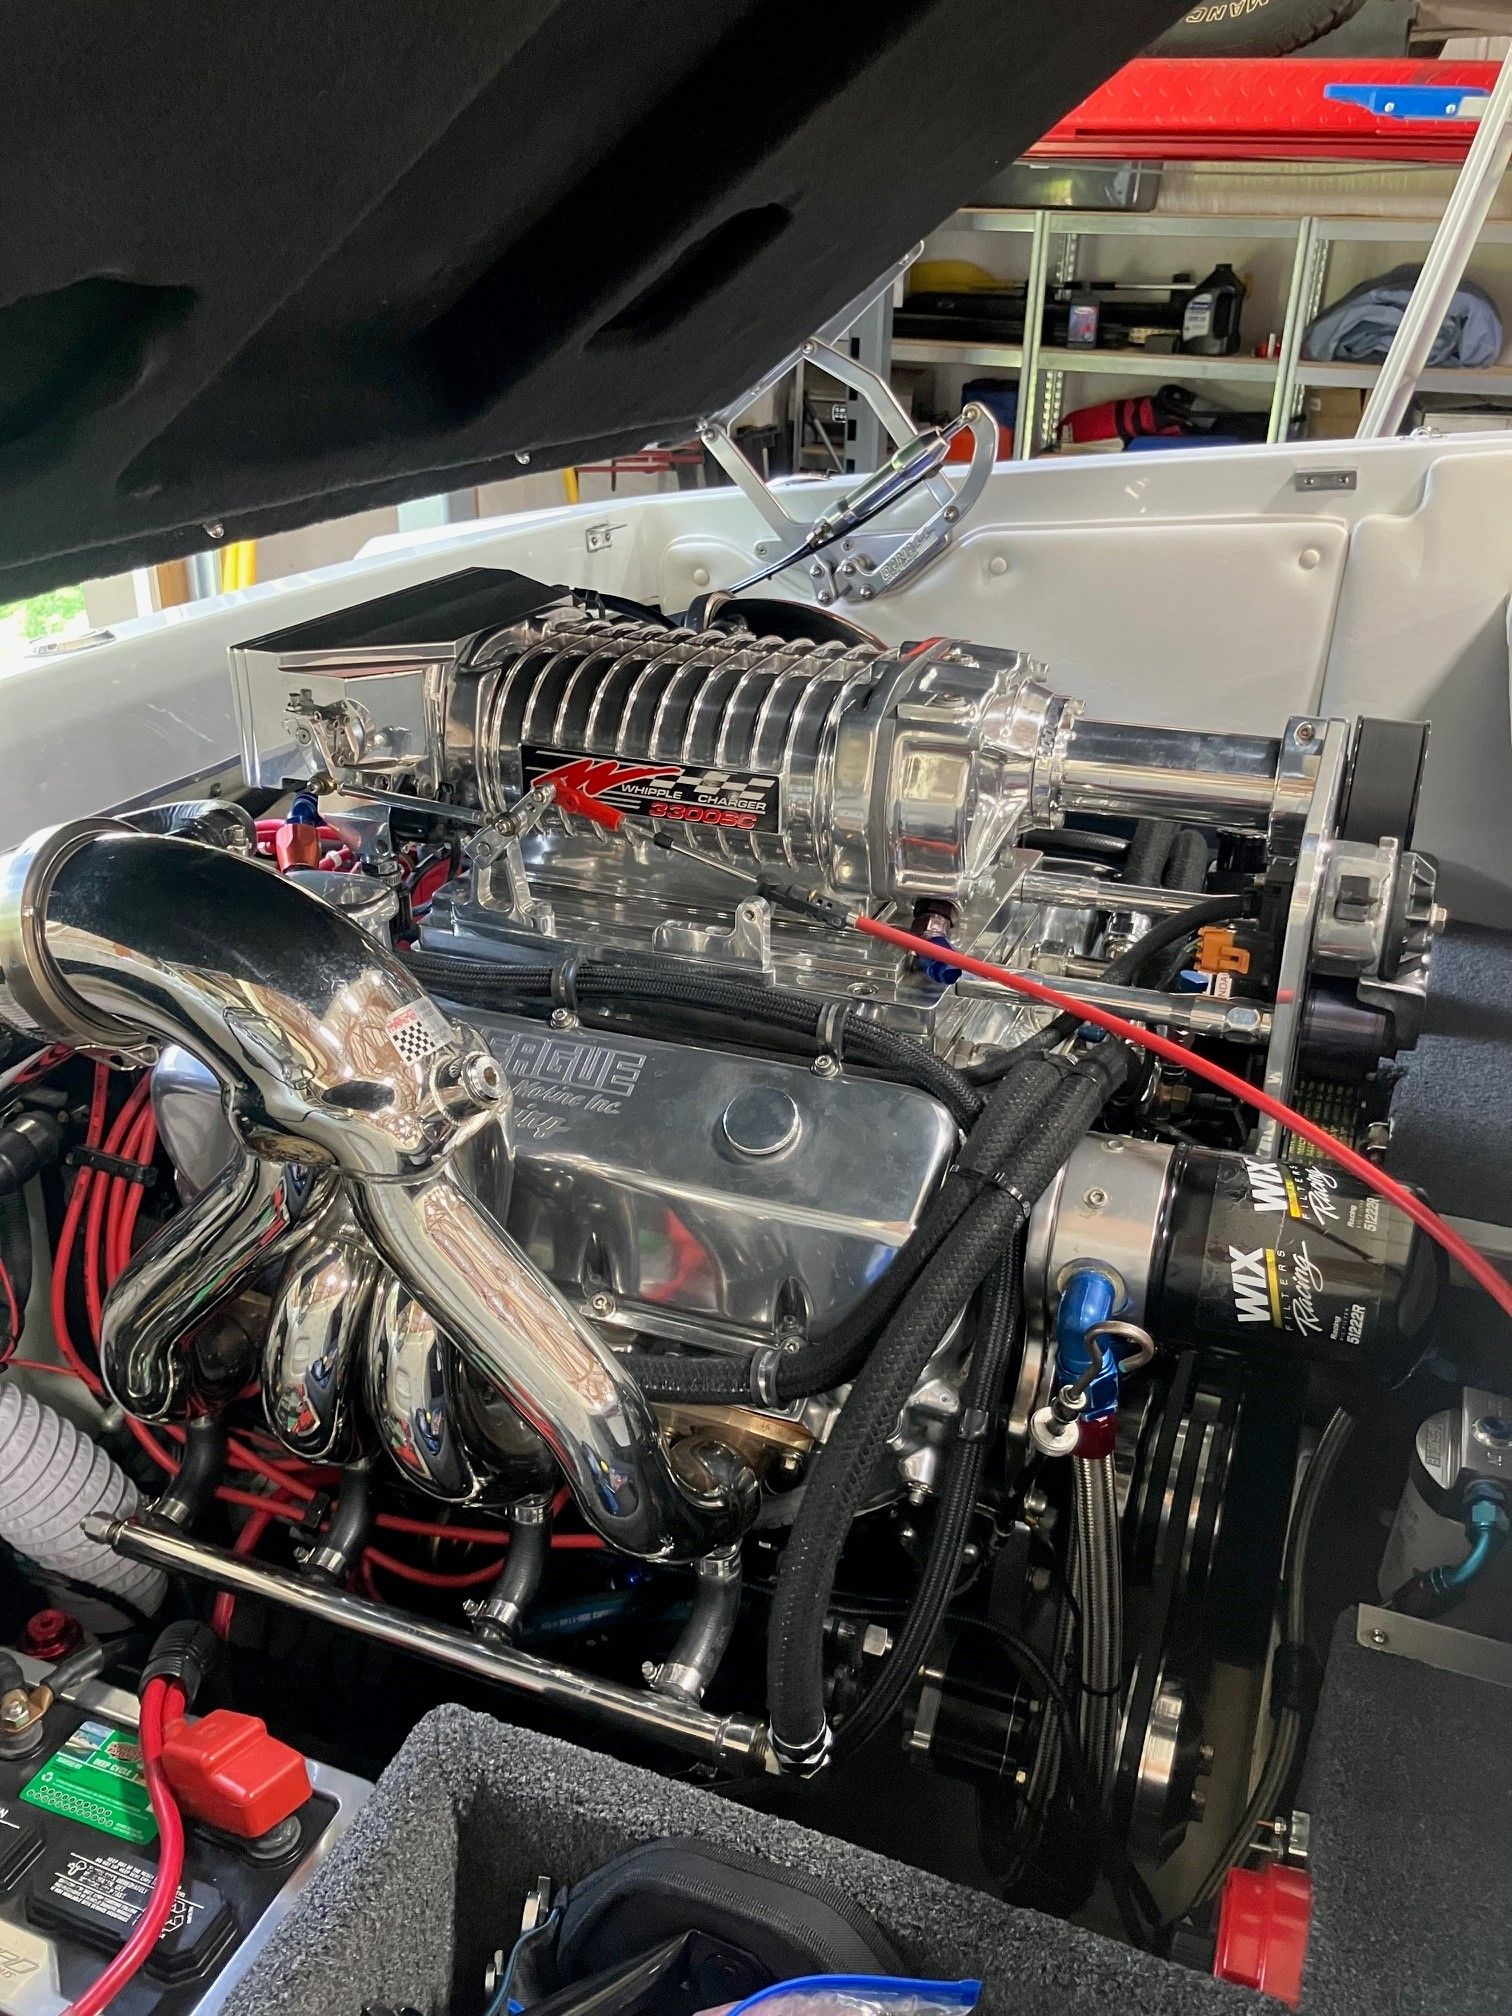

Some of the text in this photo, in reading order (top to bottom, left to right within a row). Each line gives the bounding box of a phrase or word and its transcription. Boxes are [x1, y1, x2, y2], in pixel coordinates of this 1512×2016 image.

[621, 784, 766, 811] WHIPPLE CHARGER
[649, 802, 758, 830] 3300SC
[483, 1029, 647, 1097] EAGUE
[1243, 1157, 1289, 1212] WIX
[1290, 1165, 1310, 1220] FILTERS
[1308, 1166, 1339, 1226] Racing
[1229, 1245, 1271, 1322] WIX
[1277, 1250, 1294, 1331] FILTERS
[1292, 1240, 1323, 1337] Racing
[1330, 1315, 1341, 1340] Racing
[1347, 1304, 1366, 1345] 51222R
